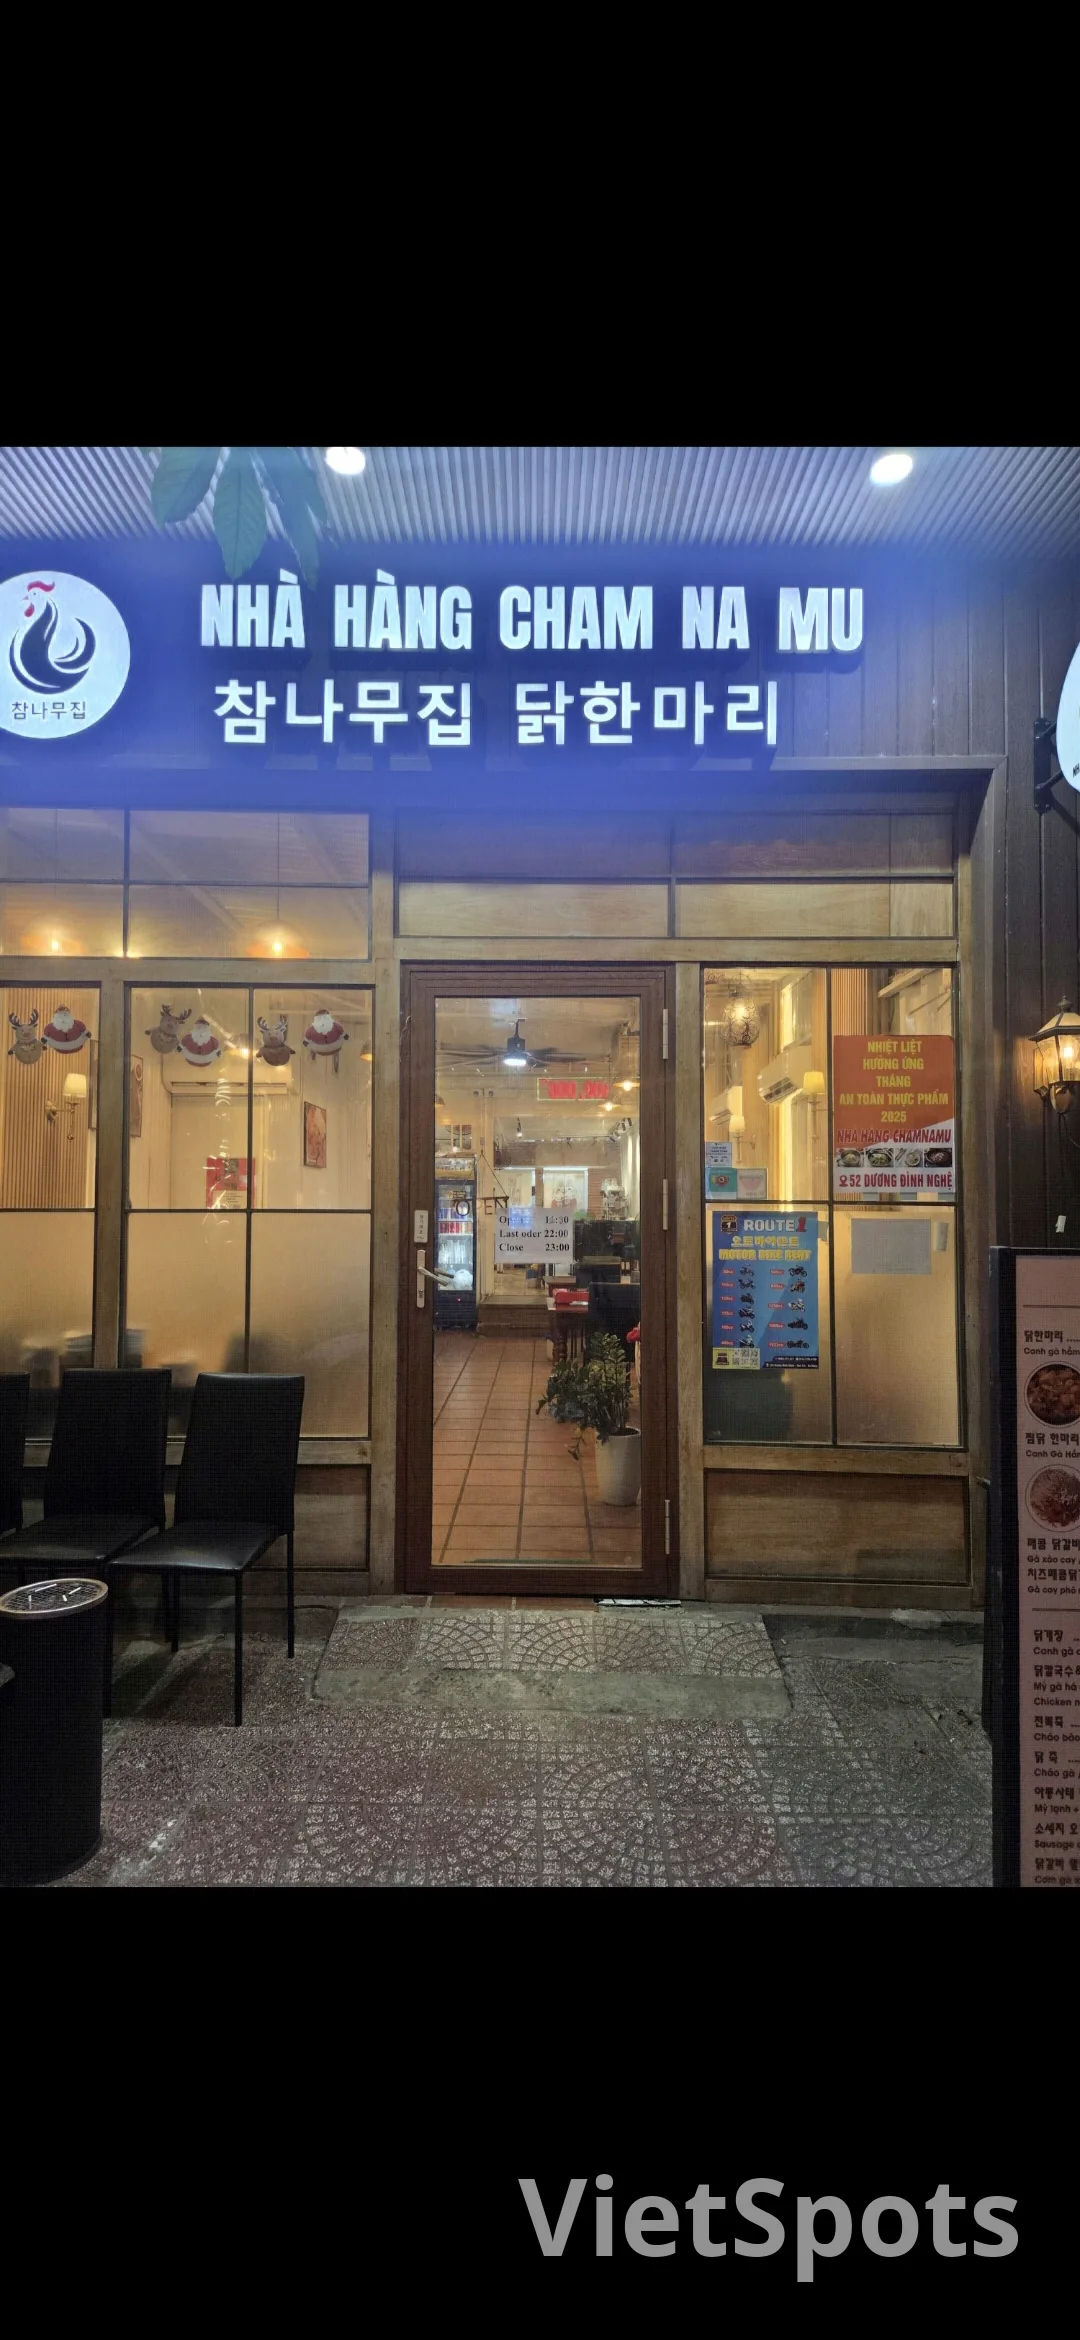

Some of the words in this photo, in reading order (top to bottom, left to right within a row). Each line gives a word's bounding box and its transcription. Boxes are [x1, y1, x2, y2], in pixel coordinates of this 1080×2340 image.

[201, 568, 306, 648] NHÀ
[334, 568, 473, 650] HÀNG
[499, 585, 654, 650] CHAM
[682, 586, 750, 650] NA
[778, 586, 864, 653] MU
[12, 701, 86, 720] 참나무집
[213, 678, 471, 747] 참나무집
[516, 680, 778, 746] 닭한마리
[867, 1039, 899, 1055] NHIỆT
[900, 1039, 922, 1055] LIỆT
[902, 1056, 924, 1070] ỨNG
[876, 1073, 911, 1088] THÁNG
[840, 1093, 854, 1105] AN
[856, 1091, 885, 1105] TOÀN
[887, 1093, 914, 1108] THỰC
[917, 1088, 949, 1105] PHẨM
[881, 1111, 907, 1122] 2025
[861, 1127, 889, 1142] HÀNG
[893, 1128, 952, 1143] CHAMNAMU
[849, 1174, 861, 1187] 52
[864, 1172, 897, 1187] DƯƠNG
[900, 1171, 923, 1187] ĐÌNH
[926, 1171, 952, 1190] NGHỆ
[499, 1229, 518, 1238] Last
[521, 1229, 541, 1238] oder
[544, 1229, 569, 1238] 22:00
[499, 1243, 524, 1252] Close
[545, 1243, 570, 1252] 23:00
[1023, 1330, 1063, 1342] 닭한마리
[1023, 1347, 1046, 1355] Canh
[1048, 1347, 1060, 1357] gà
[1050, 1432, 1080, 1446] 한마리
[1025, 1450, 1048, 1458] Canh
[1050, 1450, 1063, 1458] Gà
[1027, 1555, 1040, 1563] Gà
[1060, 1557, 1076, 1565] cay
[1027, 1585, 1040, 1593] Gà
[1042, 1587, 1058, 1595] cay
[1033, 1647, 1059, 1655] Canh
[1061, 1647, 1074, 1657] gà
[1049, 1682, 1062, 1692] gà
[1033, 1697, 1072, 1706] Chicken
[1033, 1732, 1060, 1741] Cháo
[1033, 1768, 1060, 1777] Cháo
[1062, 1768, 1075, 1779] gà
[1034, 1840, 1074, 1851] Sausage
